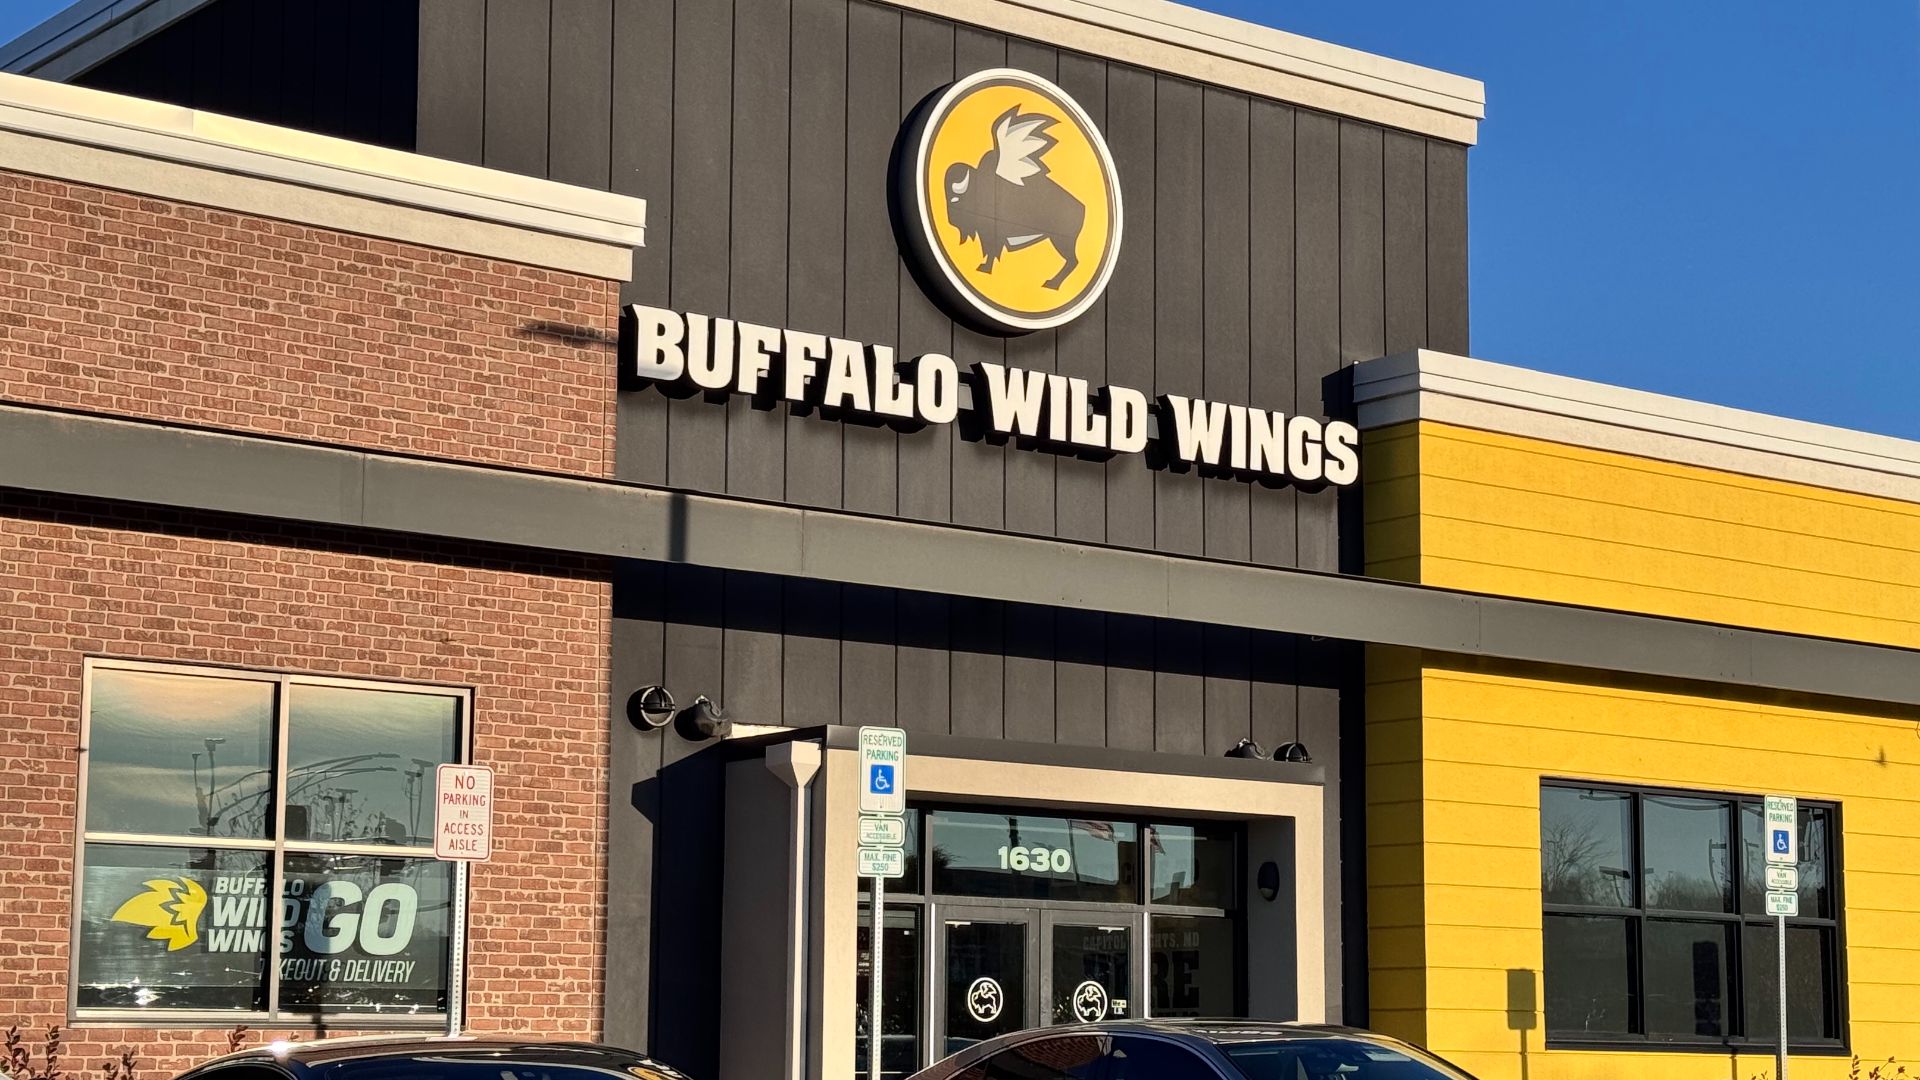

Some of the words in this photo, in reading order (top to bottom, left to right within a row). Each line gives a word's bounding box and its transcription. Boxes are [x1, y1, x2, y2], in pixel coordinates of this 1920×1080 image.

[631, 304, 959, 425] BUFFALO
[980, 361, 1148, 454] WILD
[1166, 394, 1359, 486] WINGS
[863, 734, 902, 747] RESERVED
[866, 749, 899, 761] PARKING
[455, 774, 475, 790] NO
[443, 792, 486, 806] PARKING
[1767, 800, 1794, 812] RESERVED
[460, 810, 469, 819] IN
[1769, 813, 1792, 823] PARKING
[443, 822, 484, 836] ACCESS
[874, 823, 888, 832] VAN
[448, 838, 478, 851] AISLE
[882, 853, 897, 862] FINE
[998, 846, 1072, 873] 1630
[215, 876, 305, 896] BUFFLO
[304, 880, 418, 956] GO
[258, 957, 327, 982] TKEOUT
[328, 958, 341, 982] &
[343, 959, 415, 983] DELIVERY
